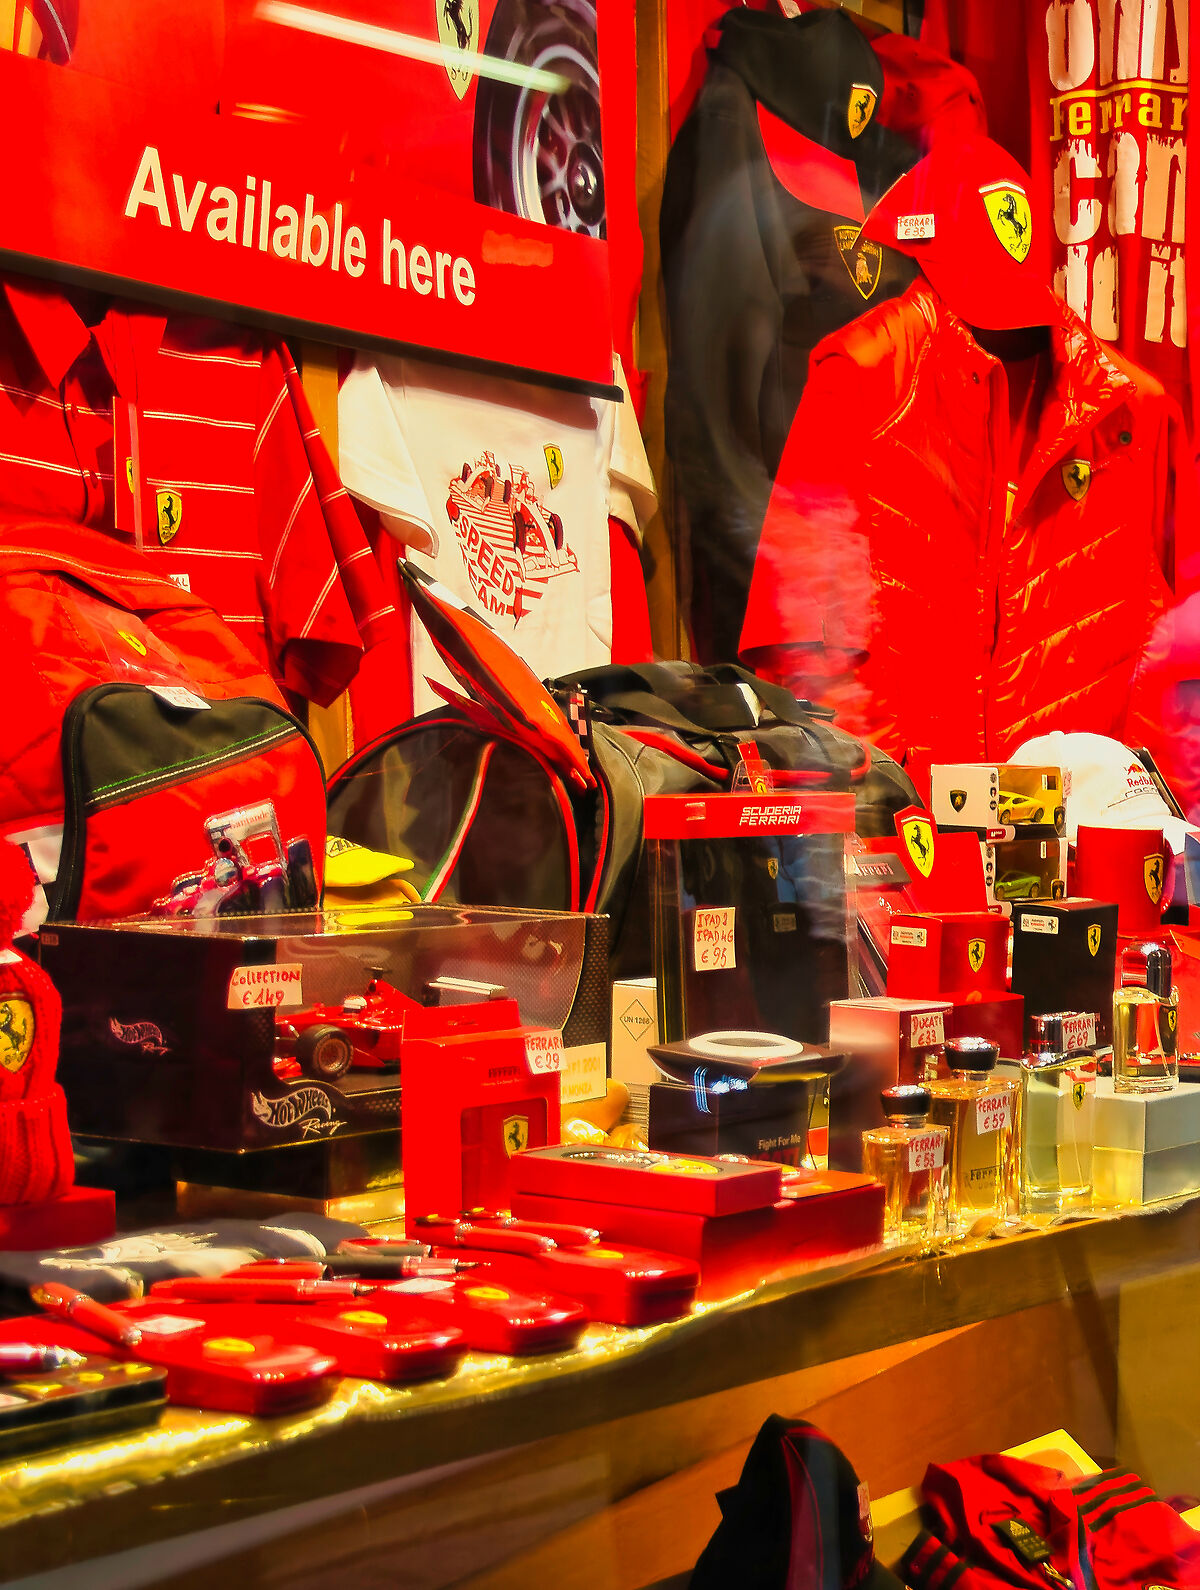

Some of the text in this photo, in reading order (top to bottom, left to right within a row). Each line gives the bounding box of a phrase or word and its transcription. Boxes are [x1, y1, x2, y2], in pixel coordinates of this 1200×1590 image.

[1053, 131, 1187, 245] can
[124, 145, 476, 306] Available here
[898, 218, 933, 228] FERRARI
[460, 515, 514, 597] SPEED
[741, 805, 802, 816] SCUDERIA
[739, 815, 800, 826] FERRARI
[912, 1015, 943, 1035] DUCATI
[1063, 1016, 1094, 1034] FERRARI
[526, 1036, 563, 1051] FERRARI
[978, 1095, 1010, 1113] FERRARI
[758, 1134, 801, 1150] Fight For Me
[909, 1134, 944, 1152] FERRARI
